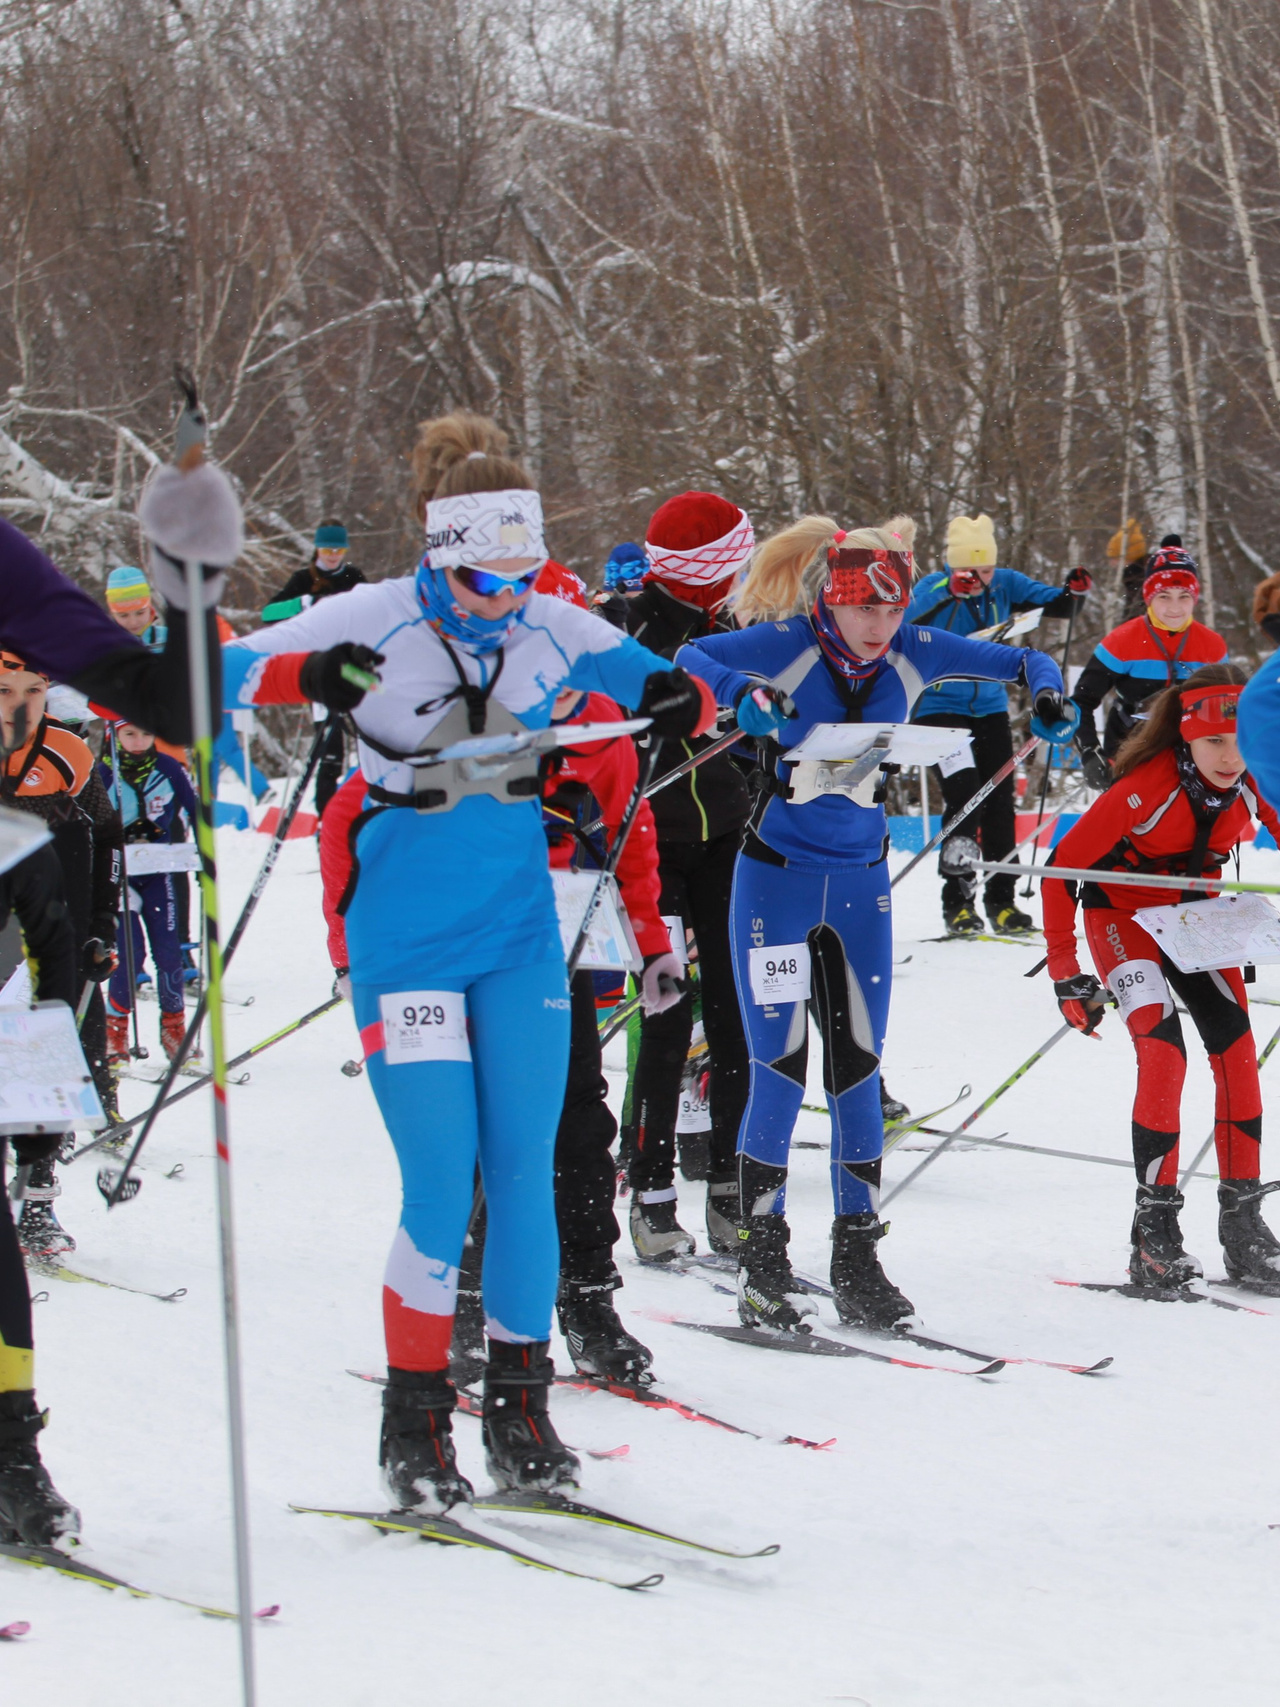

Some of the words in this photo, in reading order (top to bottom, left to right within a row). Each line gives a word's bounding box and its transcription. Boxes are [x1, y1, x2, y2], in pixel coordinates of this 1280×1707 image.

[765, 958, 798, 977] 948
[762, 977, 779, 985] Ж14
[1117, 970, 1146, 993] 936
[403, 1005, 445, 1027] 929
[745, 1285, 780, 1315] NORDWAY
